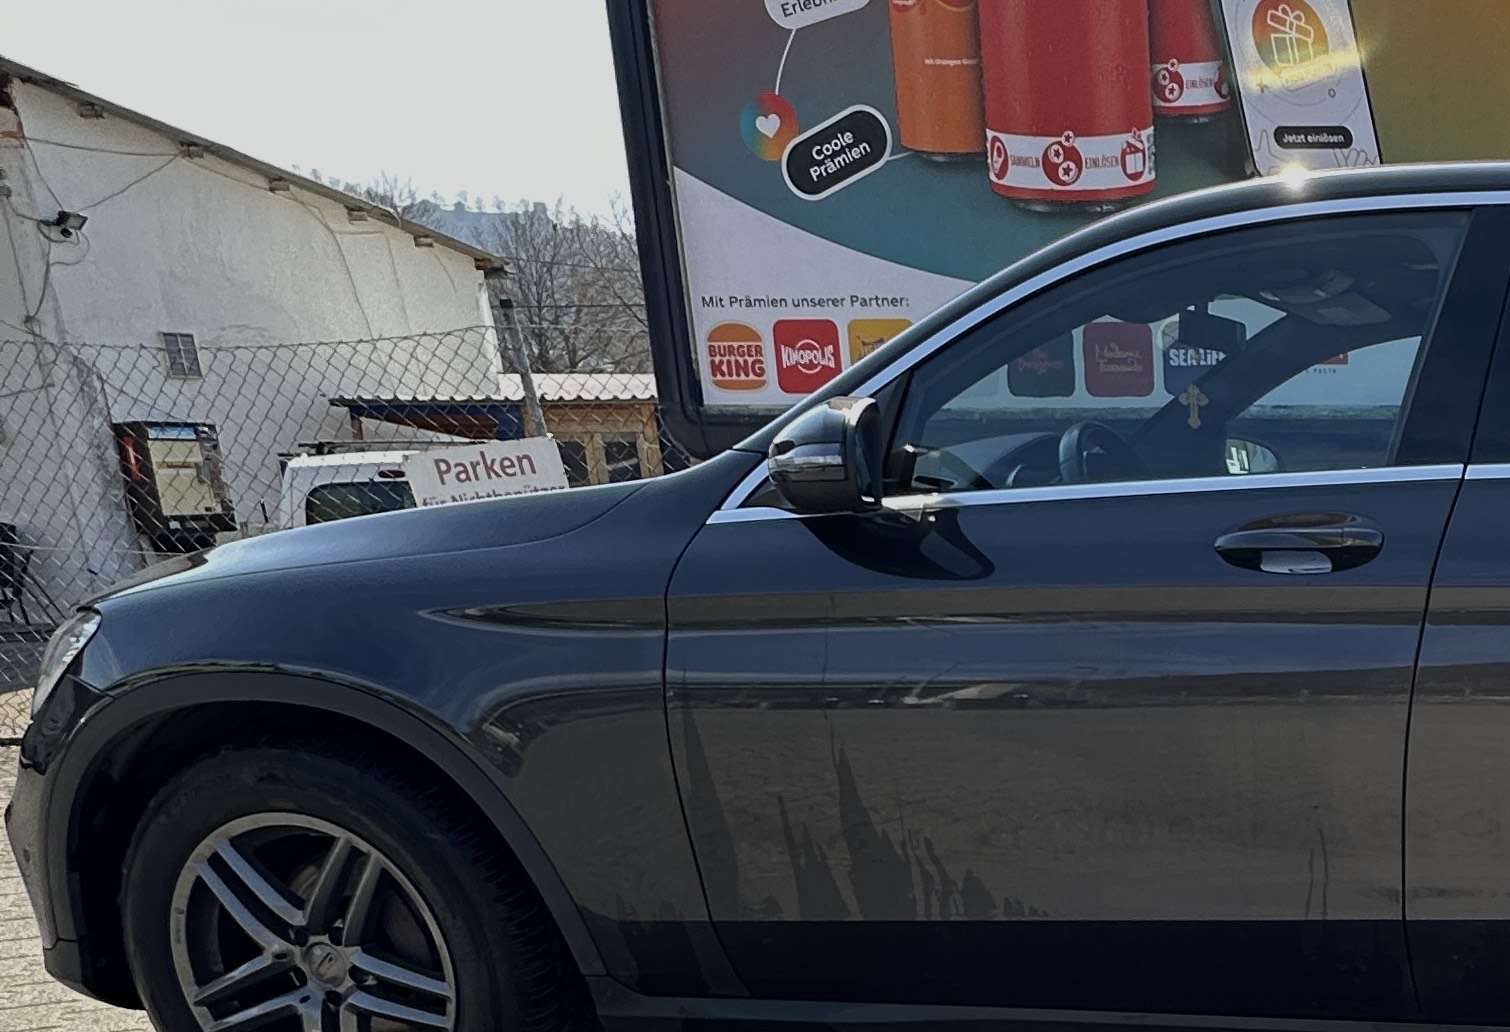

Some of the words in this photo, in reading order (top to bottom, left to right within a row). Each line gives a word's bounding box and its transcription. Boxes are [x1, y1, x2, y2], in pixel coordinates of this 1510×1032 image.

[811, 130, 855, 161] Coole
[809, 141, 871, 182] Prämien
[701, 295, 725, 308] Mit
[729, 294, 788, 309] Prämien
[791, 297, 846, 308] unserer
[850, 295, 911, 308] Partner:
[708, 343, 764, 359] BURGER
[710, 358, 766, 378] KING
[433, 450, 537, 486] Parken
